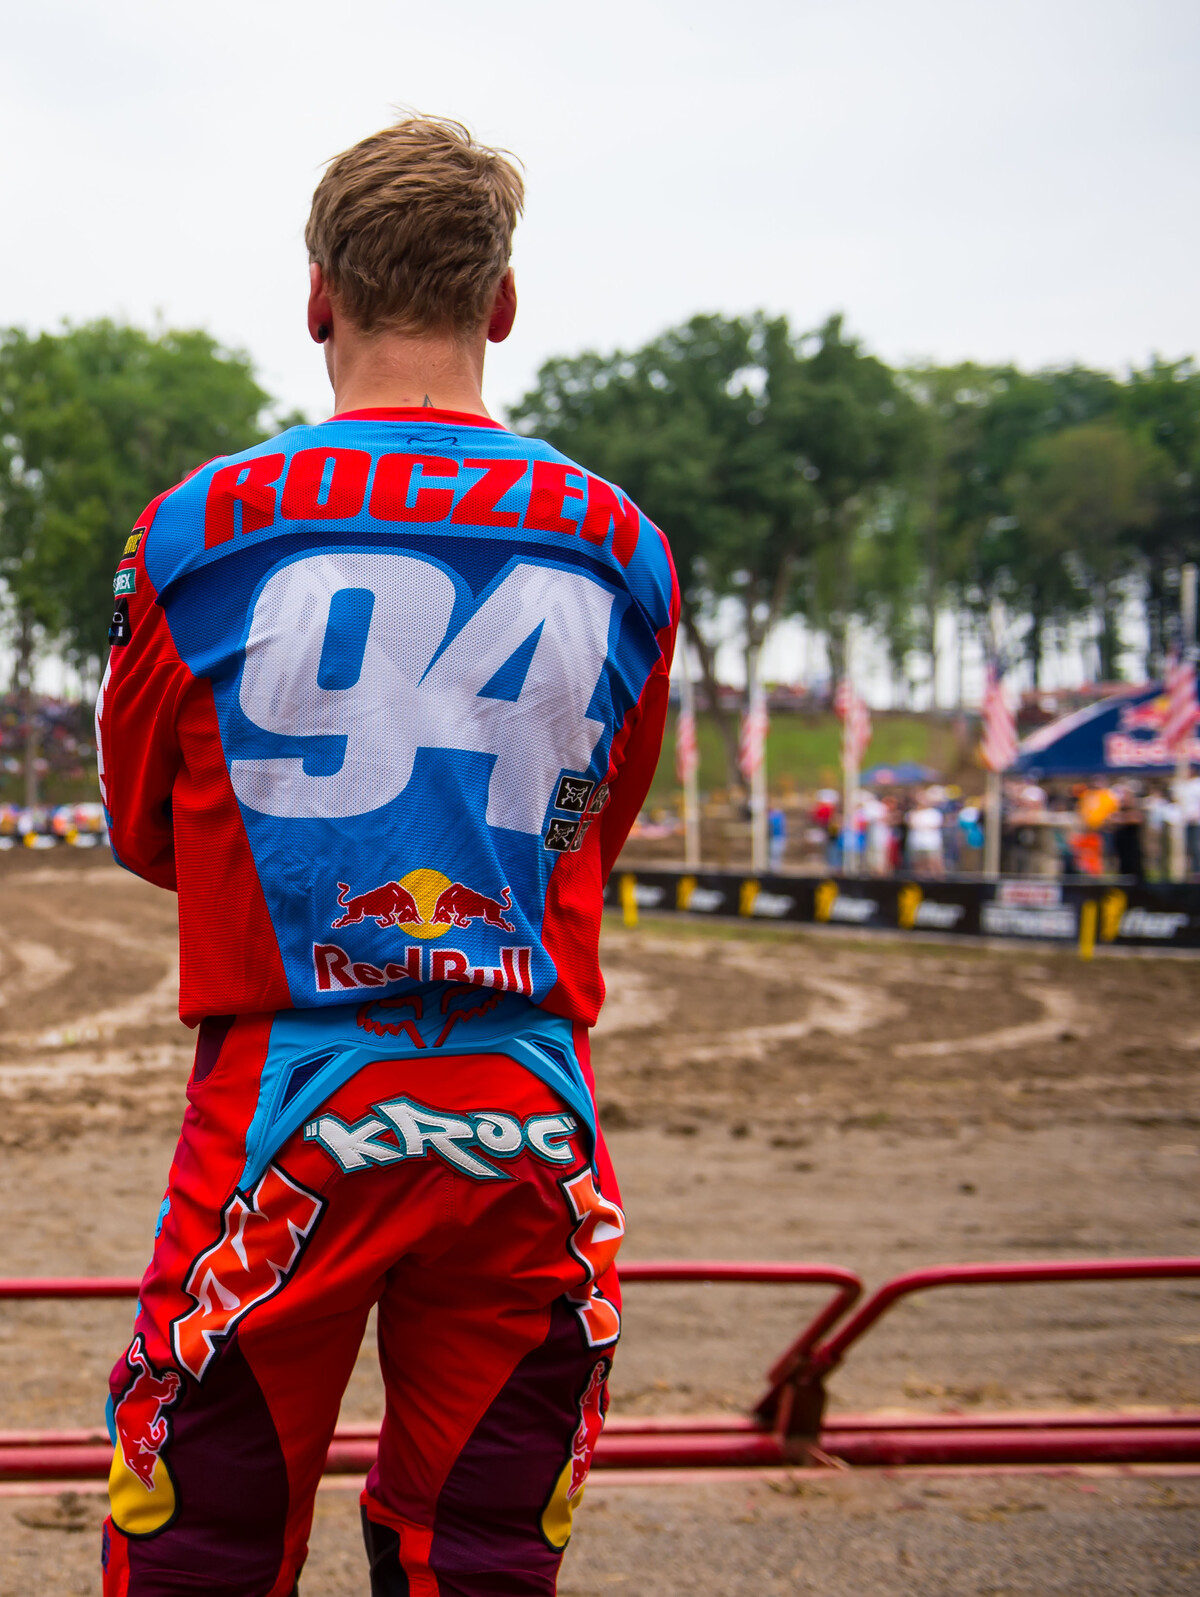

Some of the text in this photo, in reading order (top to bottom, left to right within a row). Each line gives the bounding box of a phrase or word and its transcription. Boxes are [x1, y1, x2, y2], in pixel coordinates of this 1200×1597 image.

[204, 446, 641, 569] ROCZEN
[229, 552, 617, 836] 94
[312, 942, 534, 998] Red Bull
